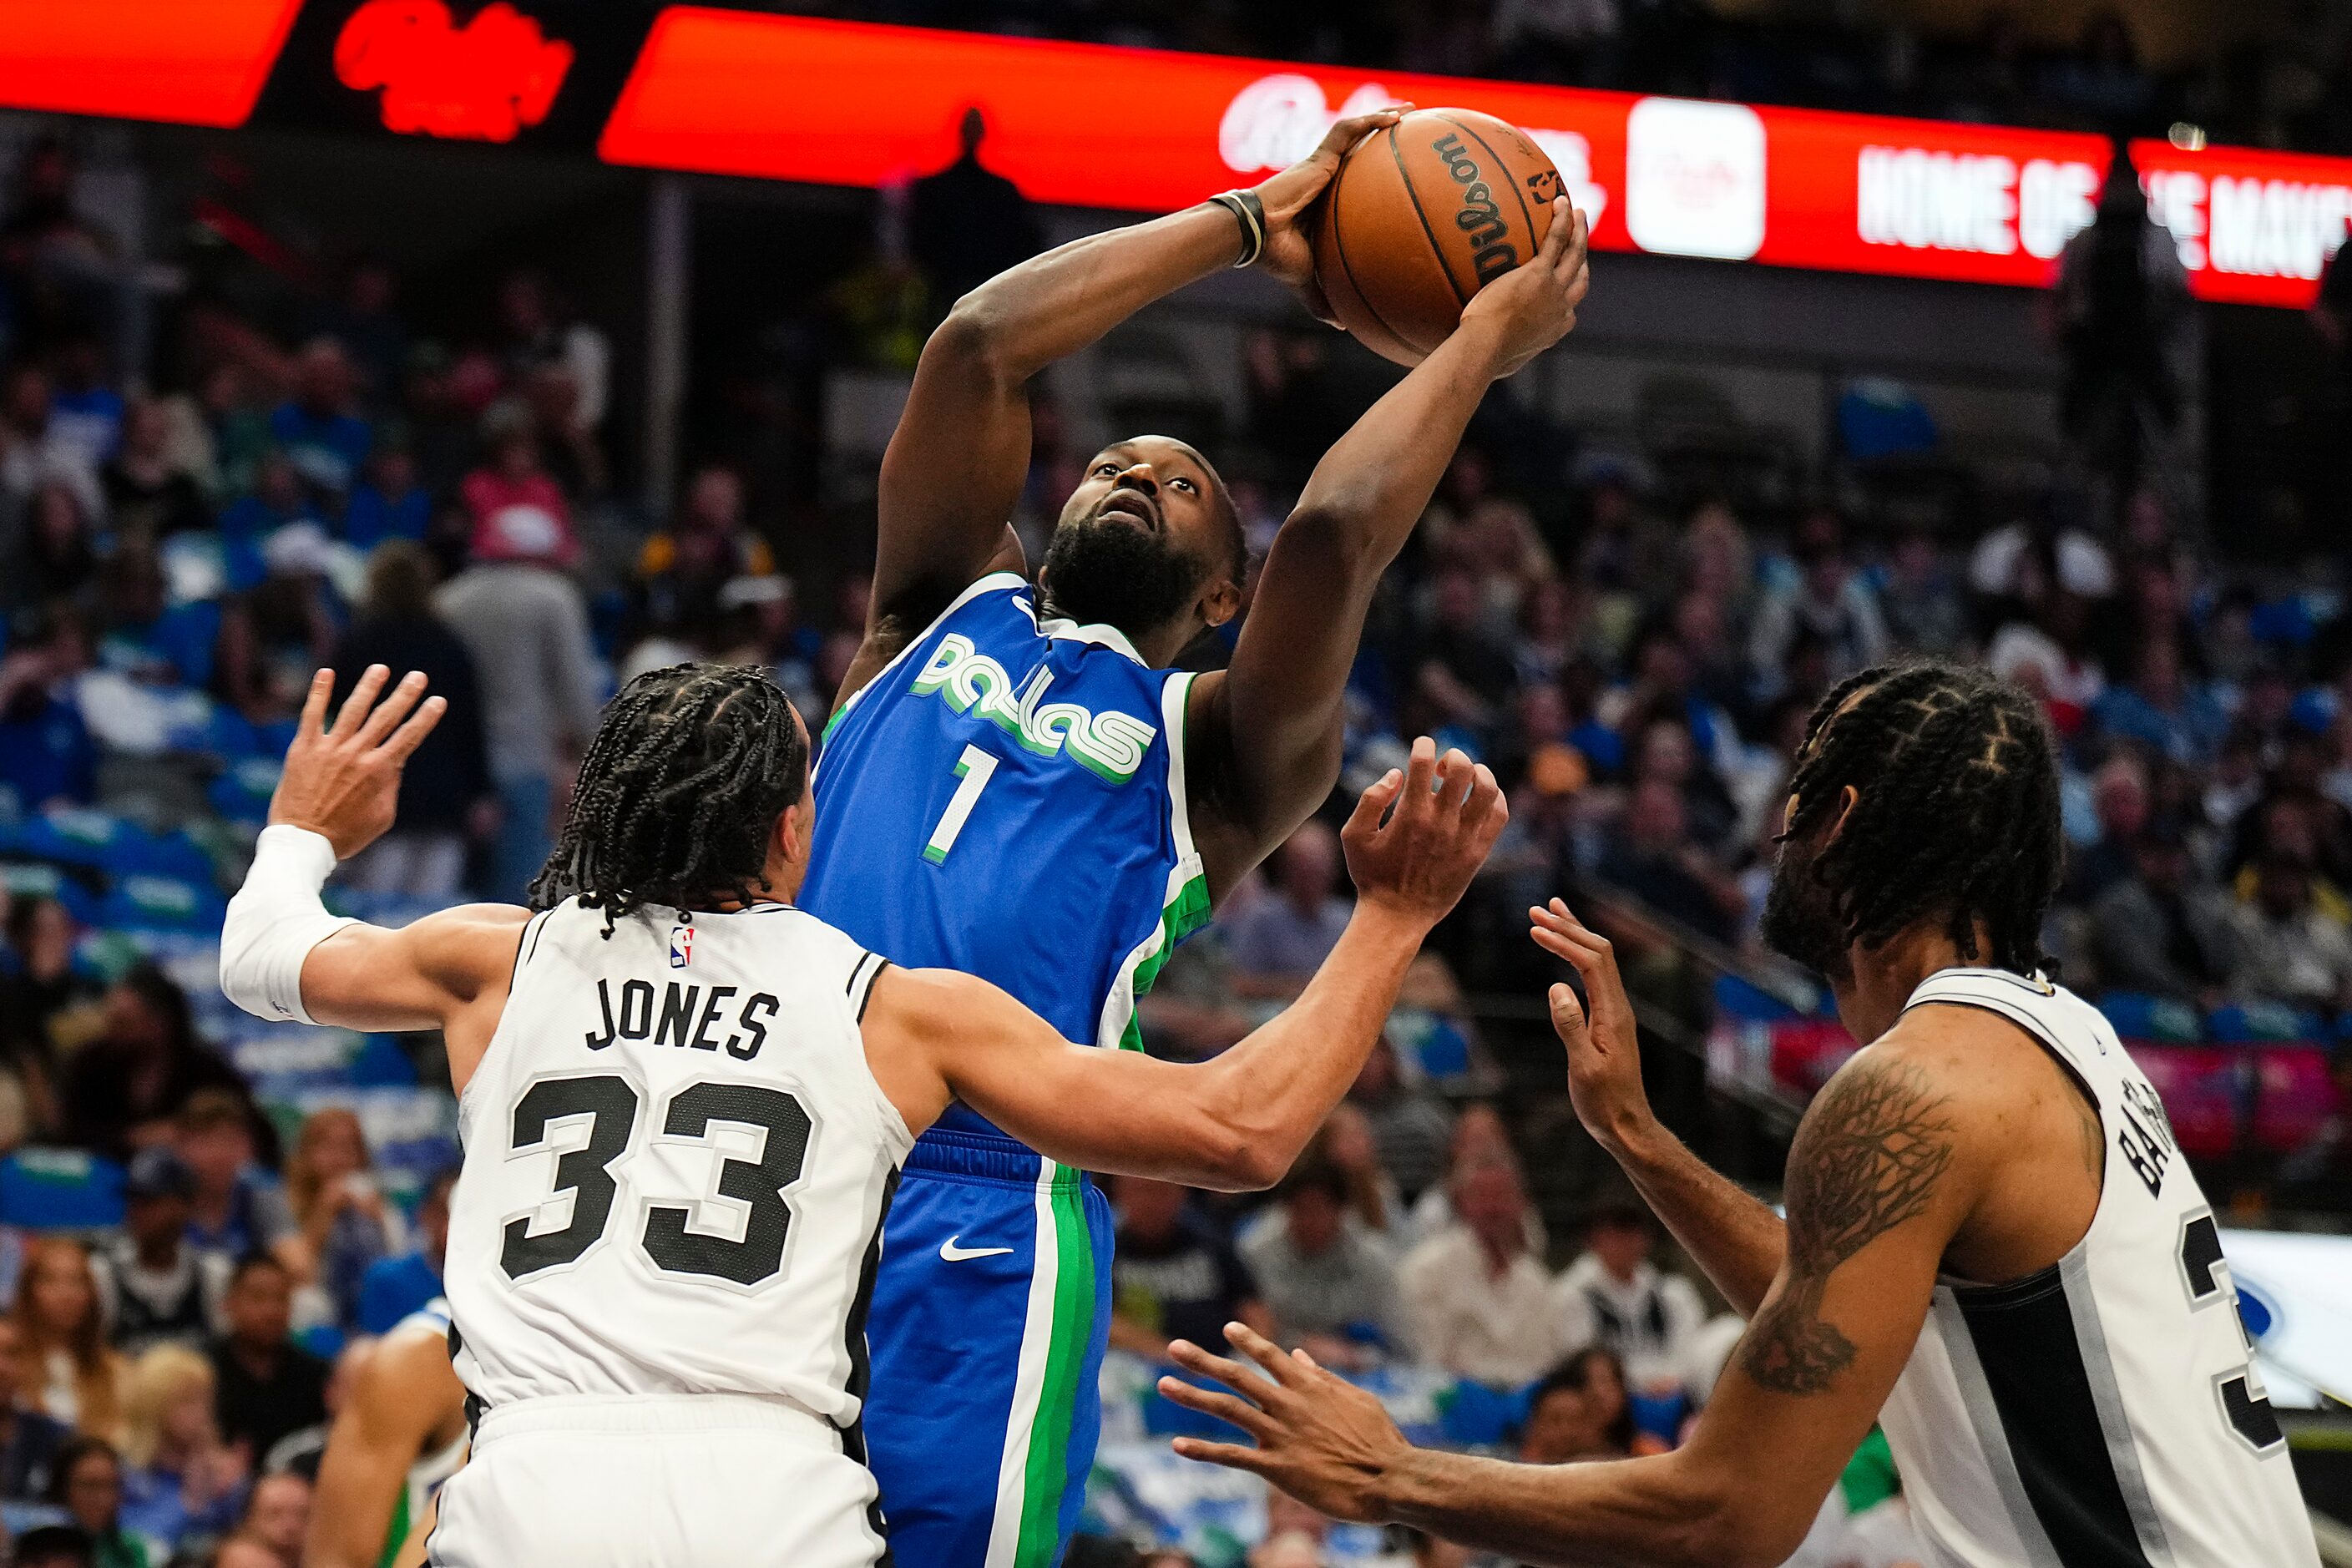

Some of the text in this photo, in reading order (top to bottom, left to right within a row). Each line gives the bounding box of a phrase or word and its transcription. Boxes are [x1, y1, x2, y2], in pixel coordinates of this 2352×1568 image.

[1858, 145, 2017, 255] HOME
[2019, 159, 2098, 260] OF
[910, 633, 1157, 787] Dallas
[920, 743, 1002, 867] 1
[585, 978, 780, 1061] JONES
[495, 1067, 822, 1295] 33
